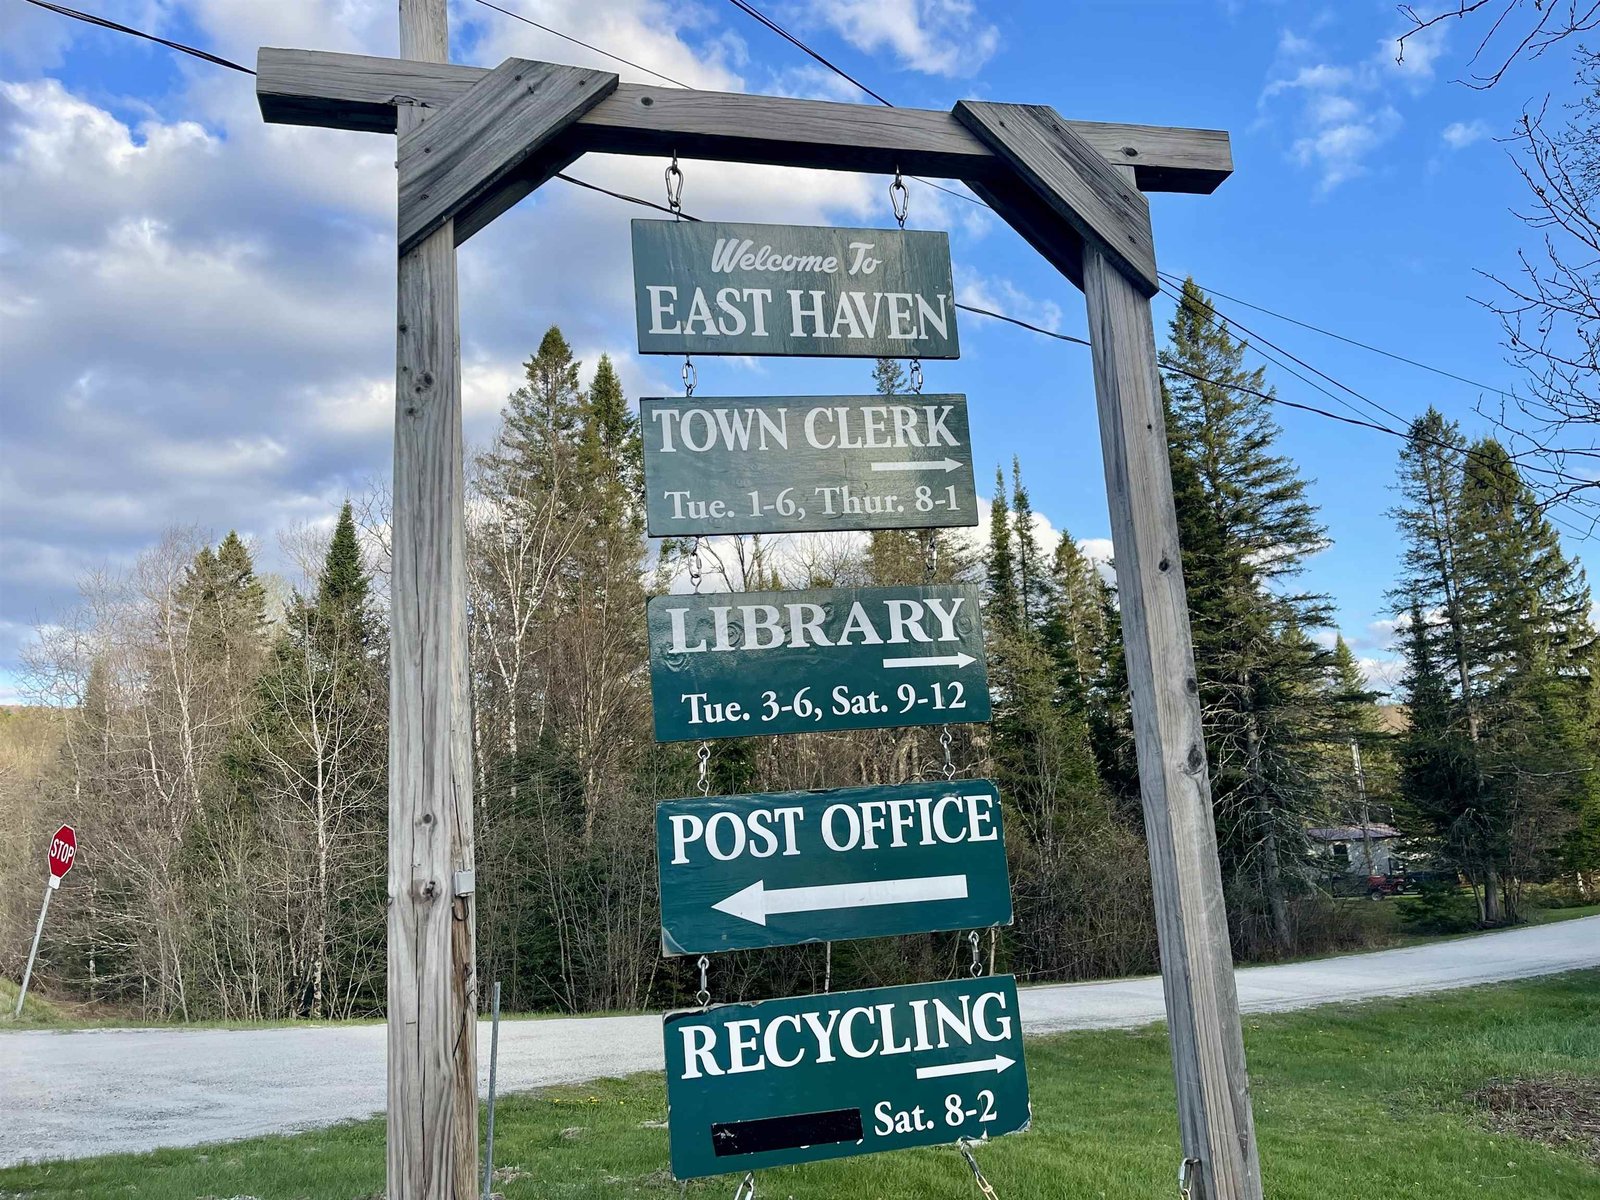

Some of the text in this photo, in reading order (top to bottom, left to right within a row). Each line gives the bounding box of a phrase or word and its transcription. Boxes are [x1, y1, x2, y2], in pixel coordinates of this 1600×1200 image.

[711, 238, 882, 275] Welcome To
[646, 285, 949, 340] EAST HAVEN
[652, 405, 960, 453] TOWN CLERK
[664, 485, 961, 521] Tue. 1-6, Thur. 8-1
[666, 598, 965, 654] LIBRARY
[681, 681, 966, 724] Tue. 3-6, Sat. 9-12
[50, 838, 75, 864] STOP
[669, 795, 998, 865] POST OFFICE
[678, 991, 1012, 1080] RECYCLING
[874, 1101, 934, 1136] Sat.
[945, 1089, 997, 1127] 8-2
